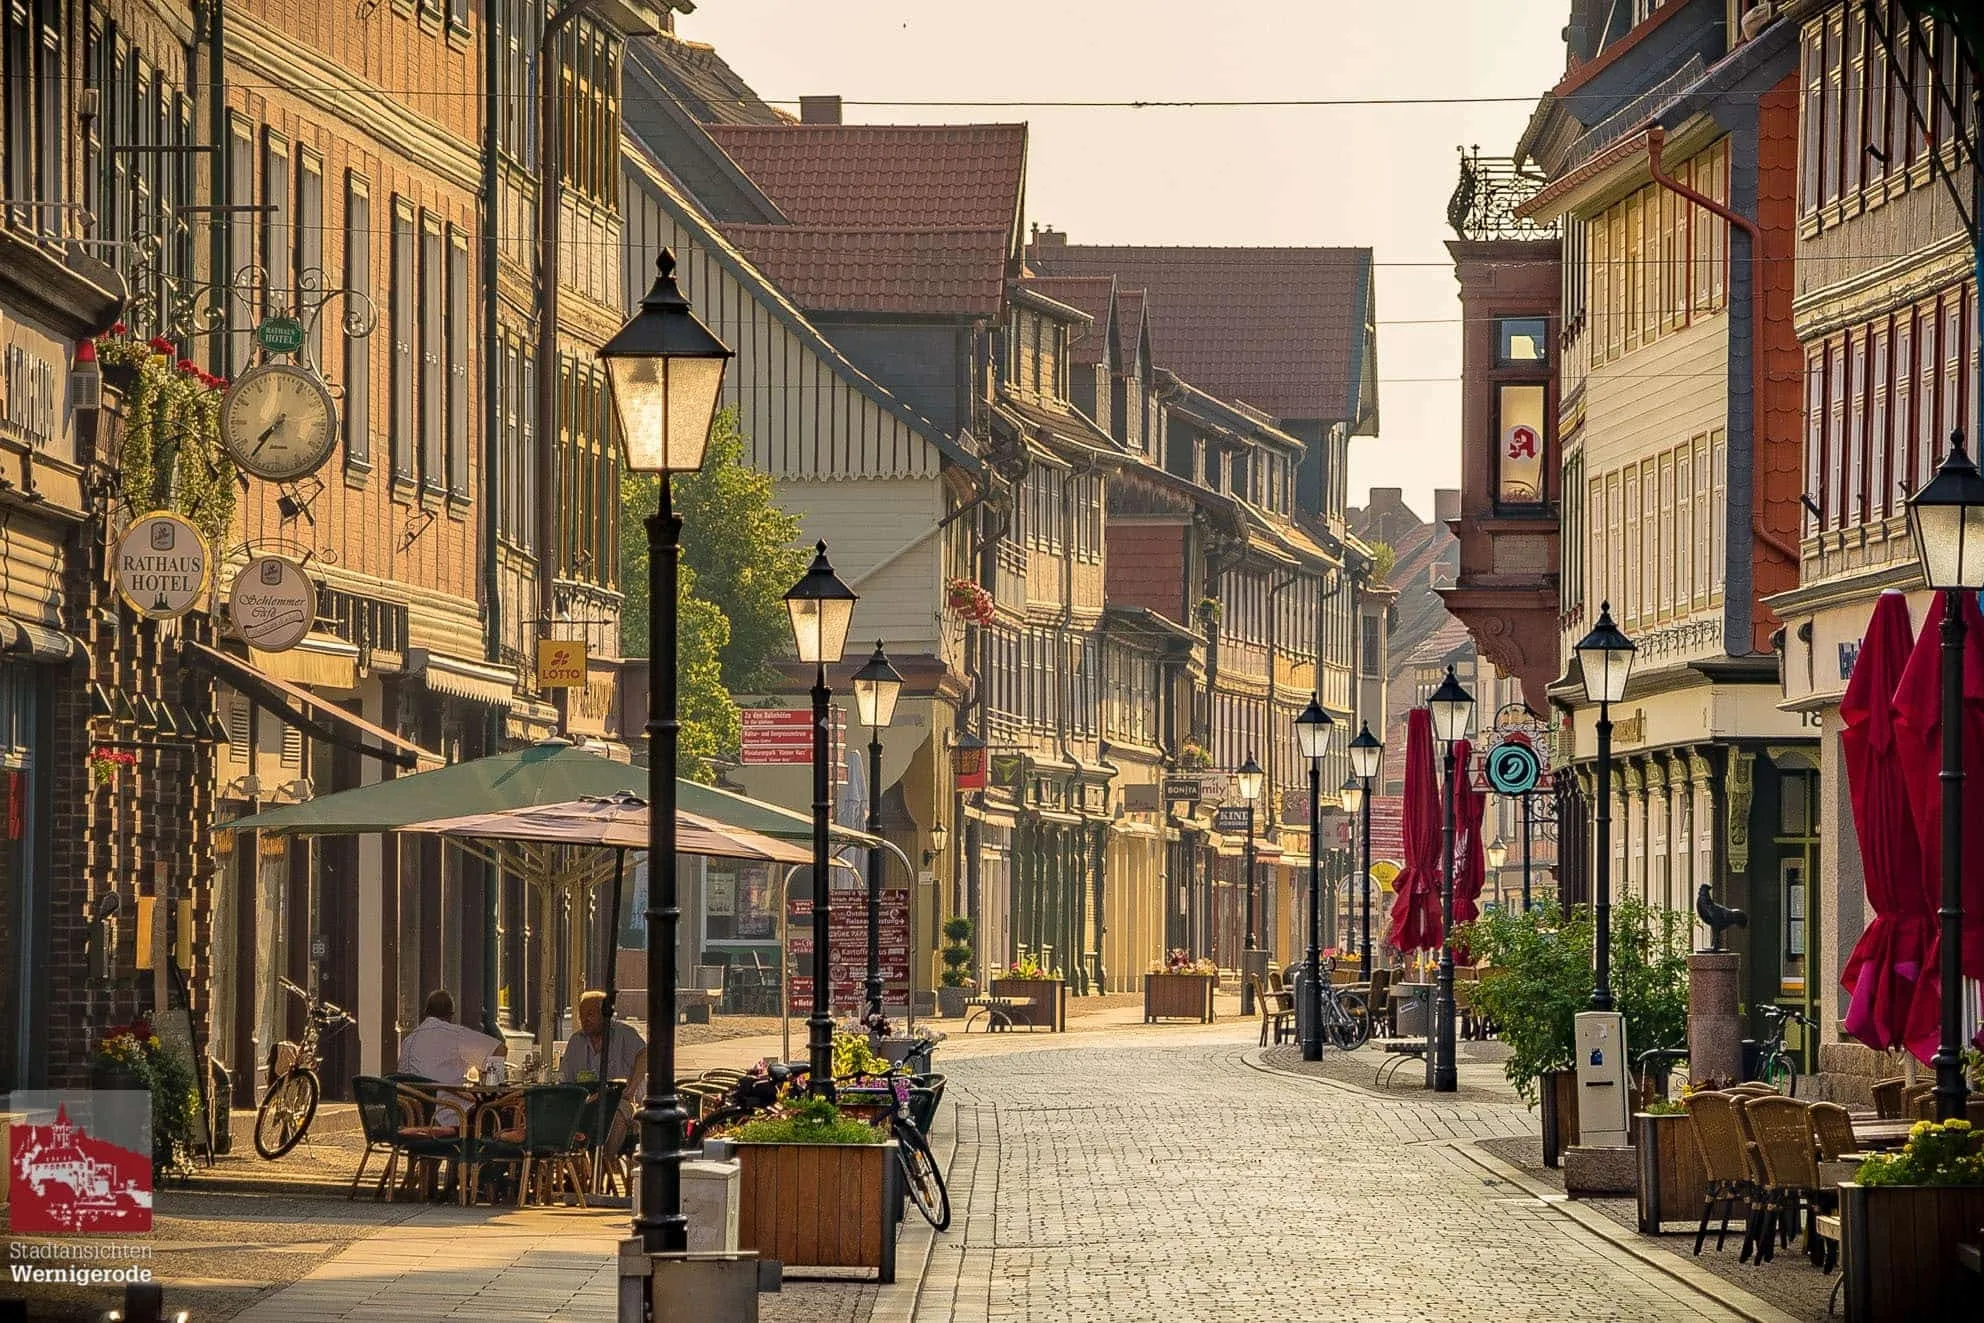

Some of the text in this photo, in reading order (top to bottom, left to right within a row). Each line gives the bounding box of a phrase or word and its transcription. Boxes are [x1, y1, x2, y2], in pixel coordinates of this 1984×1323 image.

[265, 327, 296, 335] RATHAUS
[265, 334, 295, 345] HOTEL
[123, 555, 200, 573] RATHAUS
[131, 574, 194, 592] HOTEL
[238, 594, 306, 607] Schlemmer
[542, 669, 580, 680] LOTTO
[1167, 784, 1198, 796] BONITA
[1202, 782, 1226, 797] mily
